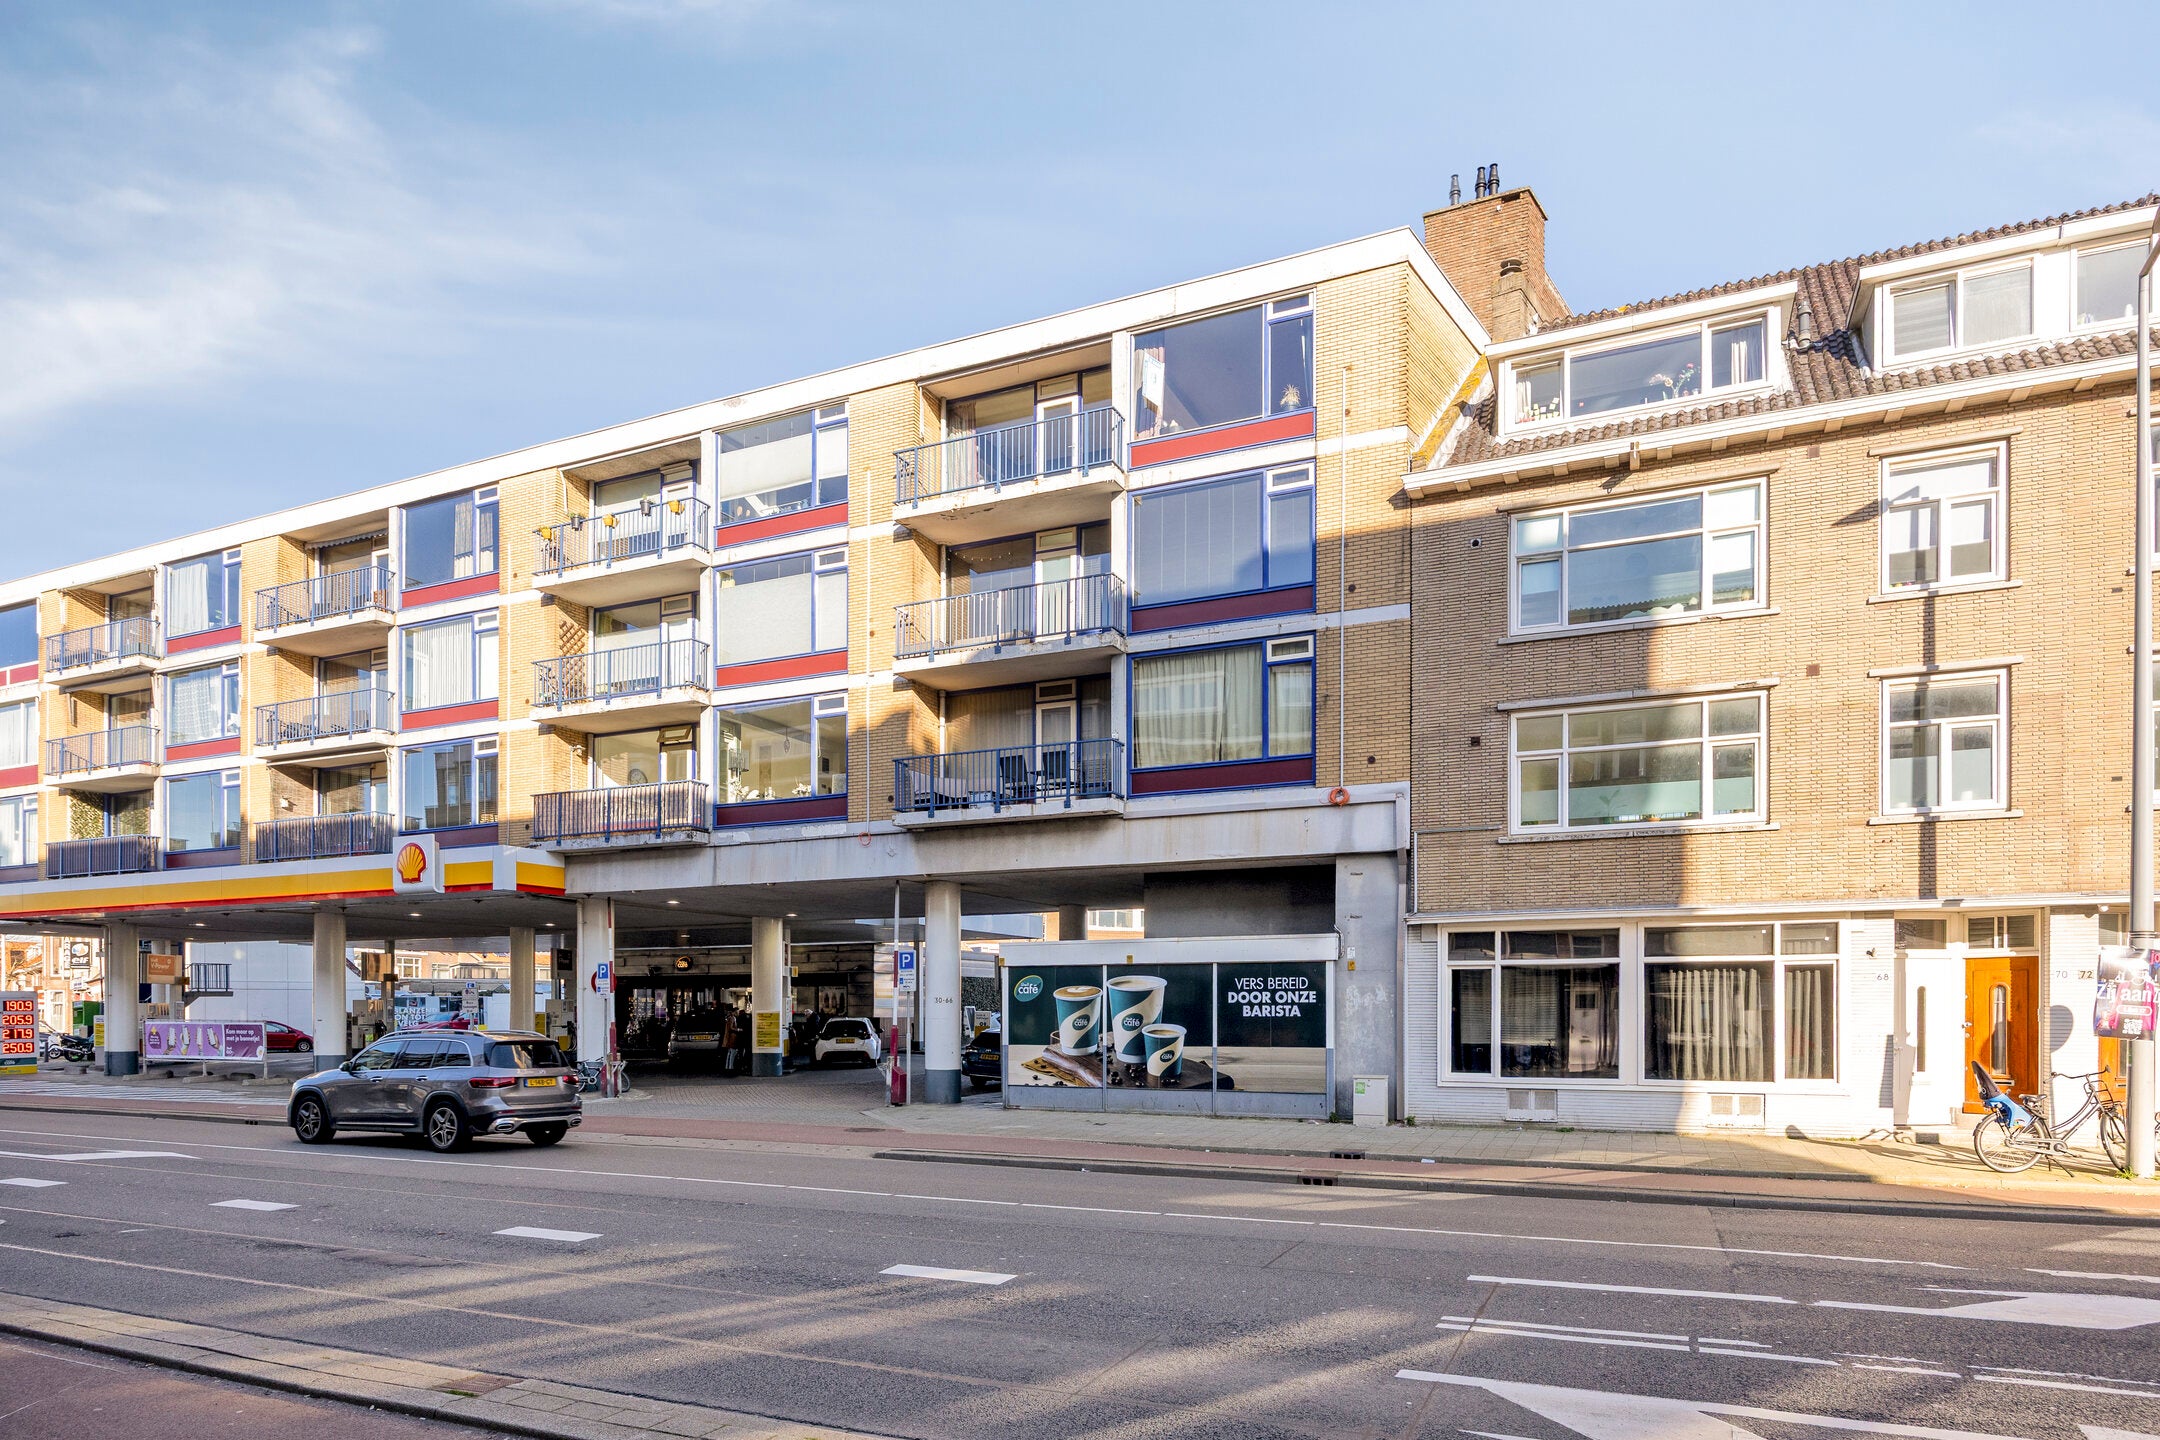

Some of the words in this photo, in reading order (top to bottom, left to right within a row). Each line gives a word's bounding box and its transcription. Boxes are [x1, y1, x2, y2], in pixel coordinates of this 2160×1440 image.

[71, 956, 89, 964] elf
[902, 954, 911, 968] P
[600, 966, 607, 978] P
[1876, 973, 1890, 982] 68
[2055, 970, 2068, 979] 70
[2079, 970, 2093, 979] 72
[1234, 977, 1264, 990] VERS
[1267, 976, 1309, 990] BEREID
[1018, 984, 1039, 994] café
[2097, 980, 2117, 1003] Zij
[2120, 988, 2152, 1003] aan
[1227, 991, 1272, 1004] DOOR
[1275, 990, 1317, 1003] ONZE
[6, 1001, 33, 1011] 190.9
[1242, 1004, 1301, 1017] BARISTA
[2, 1014, 33, 1025] 205.9
[2, 1043, 33, 1054] 250.9
